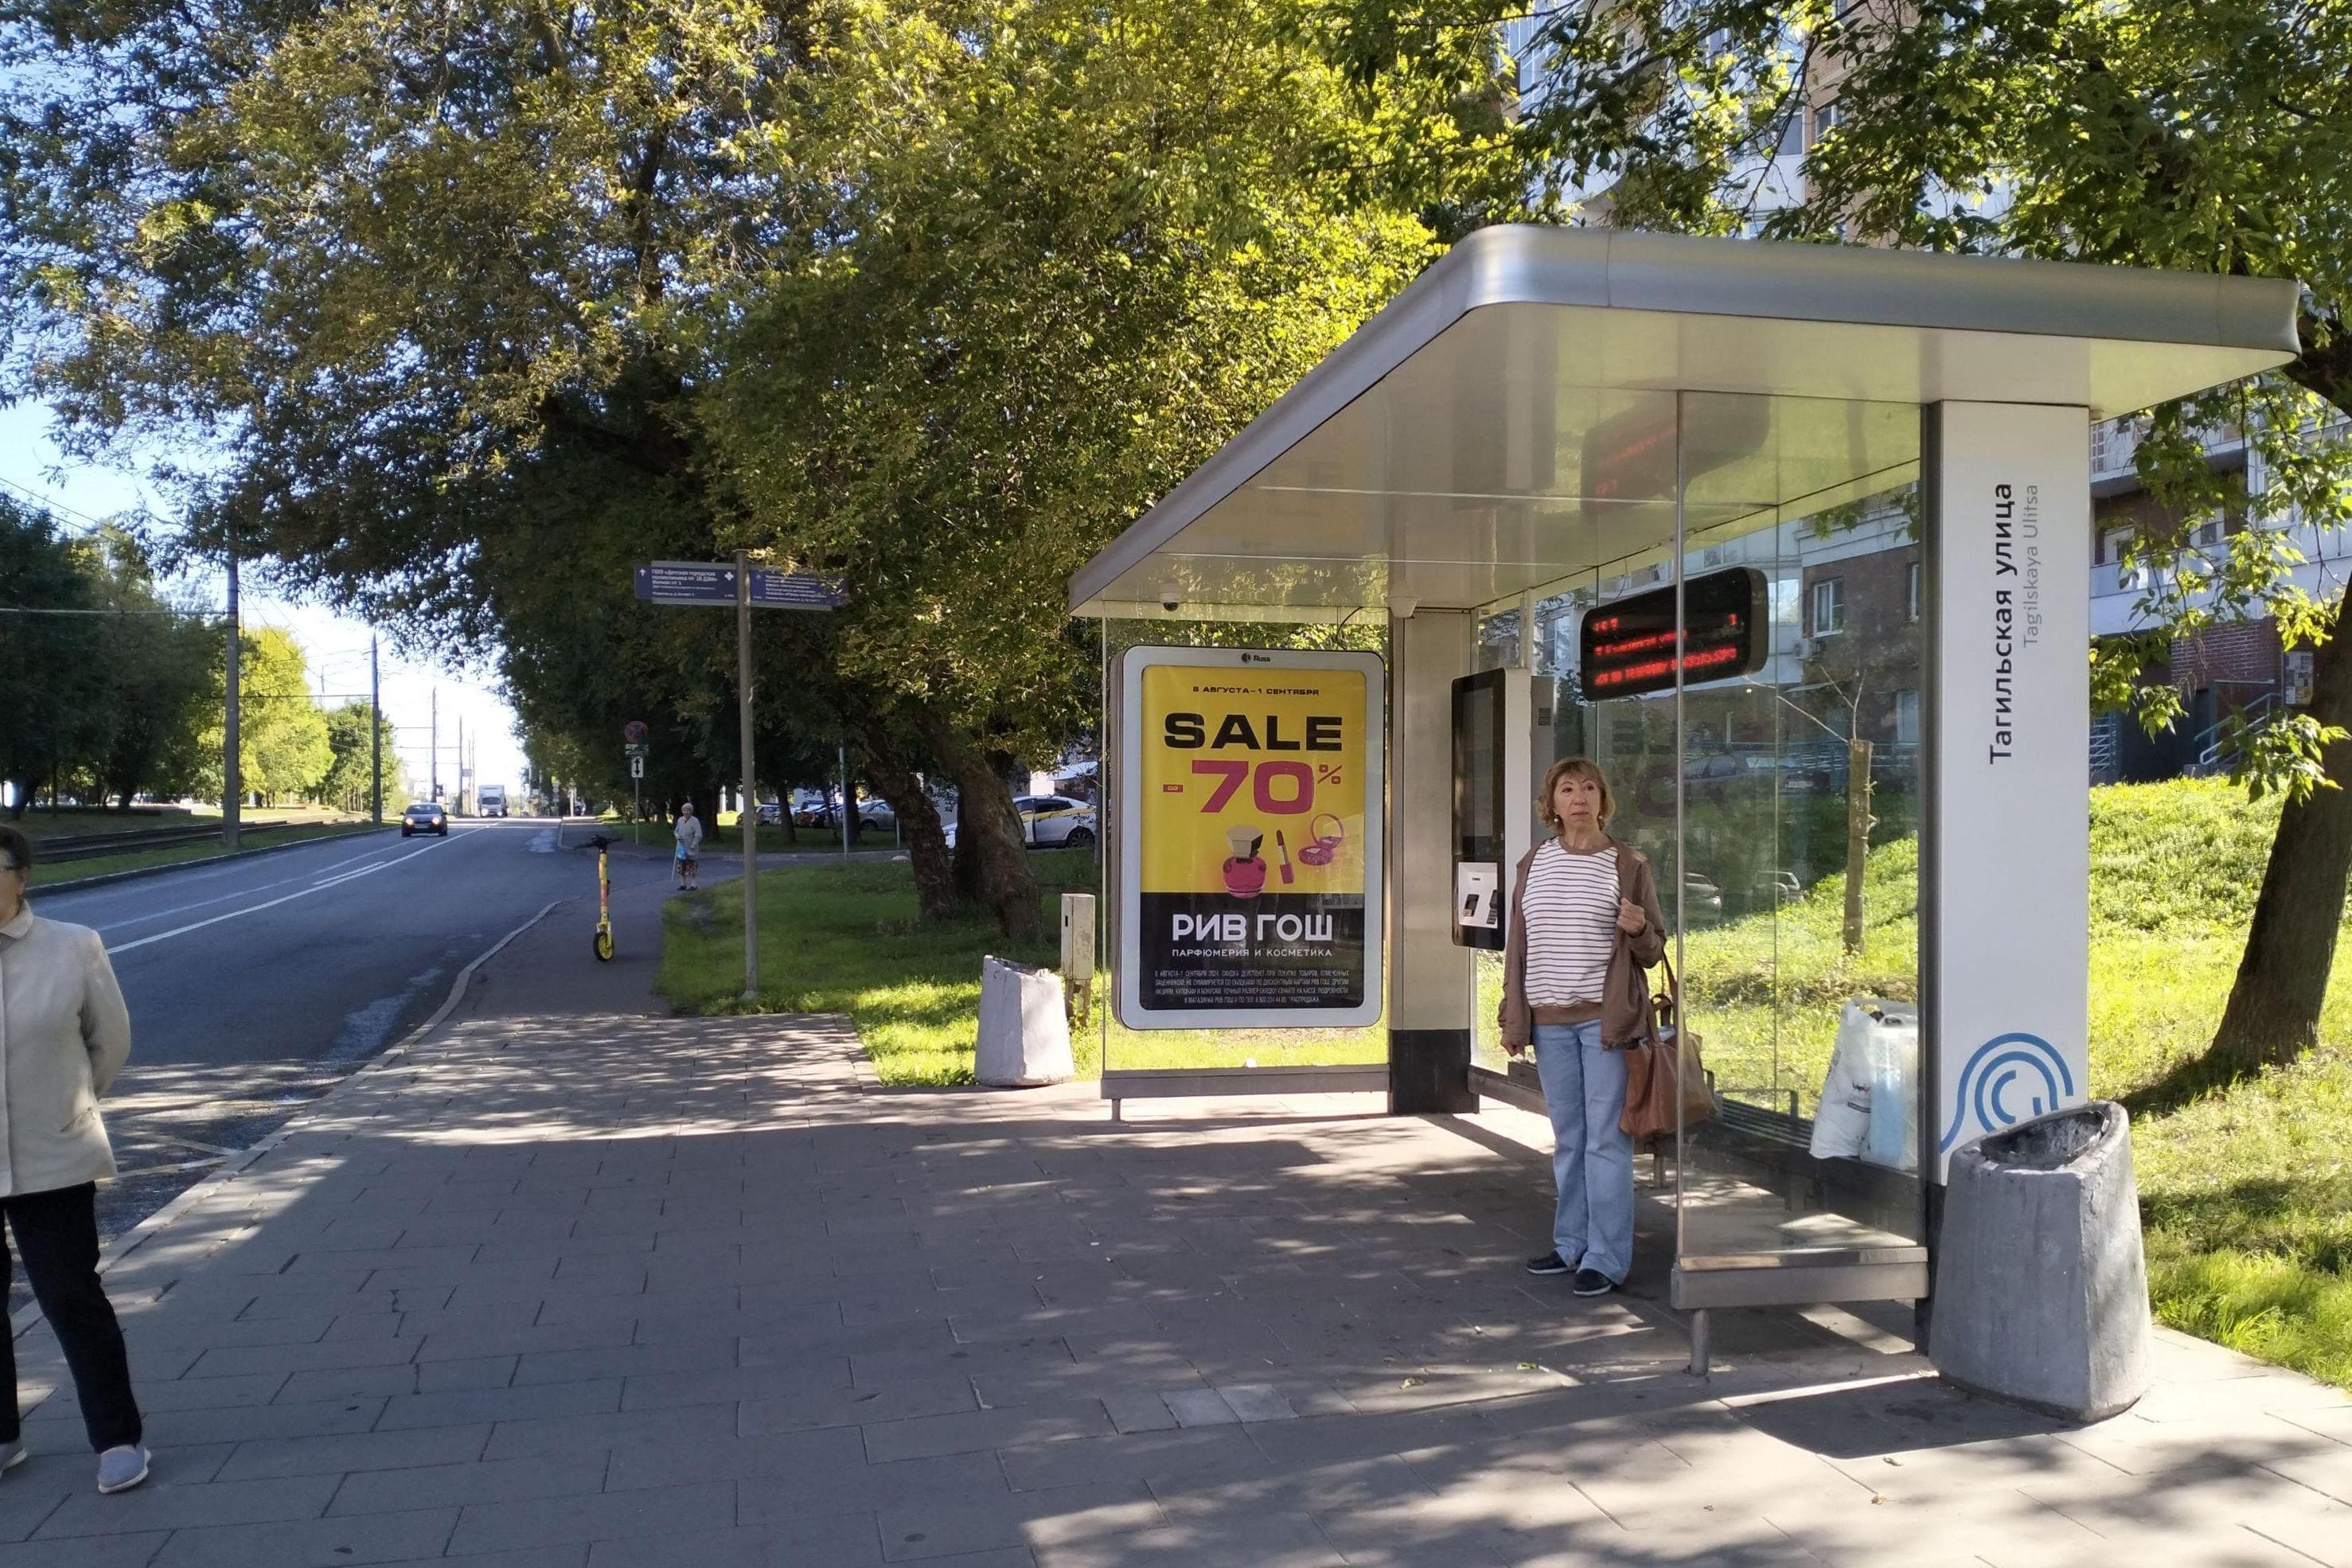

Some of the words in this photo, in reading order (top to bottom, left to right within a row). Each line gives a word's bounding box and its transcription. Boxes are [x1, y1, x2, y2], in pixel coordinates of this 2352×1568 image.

[1995, 483, 2018, 576] улица
[2022, 484, 2038, 538] Ulitsa
[2023, 545, 2042, 648] Tagilskaya
[1990, 590, 2012, 765] Тагильская
[1164, 712, 1343, 751] SALE
[1172, 914, 1246, 941] РИВ
[1257, 914, 1332, 941] ГОШ
[1172, 949, 1250, 958] ПАРФЮМЕРИЯ
